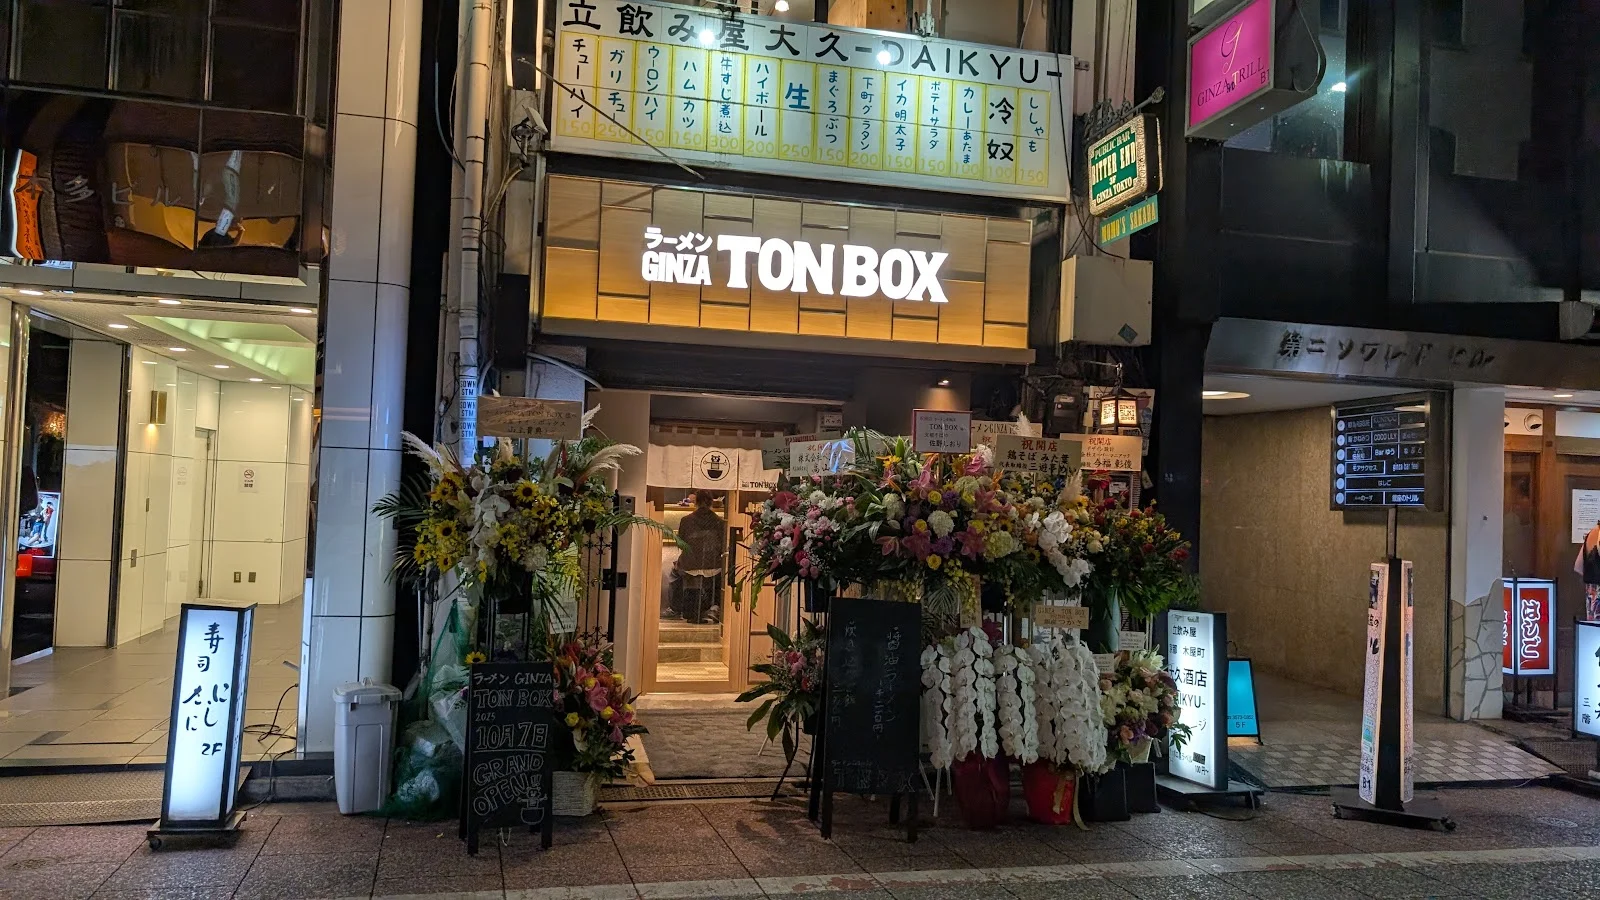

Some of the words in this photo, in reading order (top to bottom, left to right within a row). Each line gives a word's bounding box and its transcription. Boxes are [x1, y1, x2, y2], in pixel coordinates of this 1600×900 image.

[570, 38, 589, 119] チューハイ
[607, 49, 626, 124] ガリチュー
[644, 45, 660, 121] ウーロンハイ
[682, 61, 697, 128] ハムカツ
[754, 63, 770, 137] ハイボール
[784, 82, 811, 110] 生
[825, 70, 840, 144] まぐろぶつ
[894, 79, 907, 152] イカ明太子
[986, 96, 1015, 162] 冷奴
[1028, 96, 1044, 153] ししゃも
[746, 139, 775, 155] 200
[783, 143, 810, 158] 250
[851, 151, 879, 166] 200
[1091, 152, 1117, 185] BITTER
[1119, 141, 1136, 169] END
[644, 226, 713, 253] ラーメン
[641, 250, 713, 286] GINZA
[717, 234, 836, 296] TON
[840, 243, 949, 303] BOX
[1021, 438, 1058, 452] 祝開店
[473, 672, 510, 685] ラーメン
[514, 672, 553, 685] GINZA
[473, 688, 515, 709] TON
[516, 688, 554, 708] BOX
[201, 742, 223, 756] 2F
[473, 753, 545, 787] GRAND
